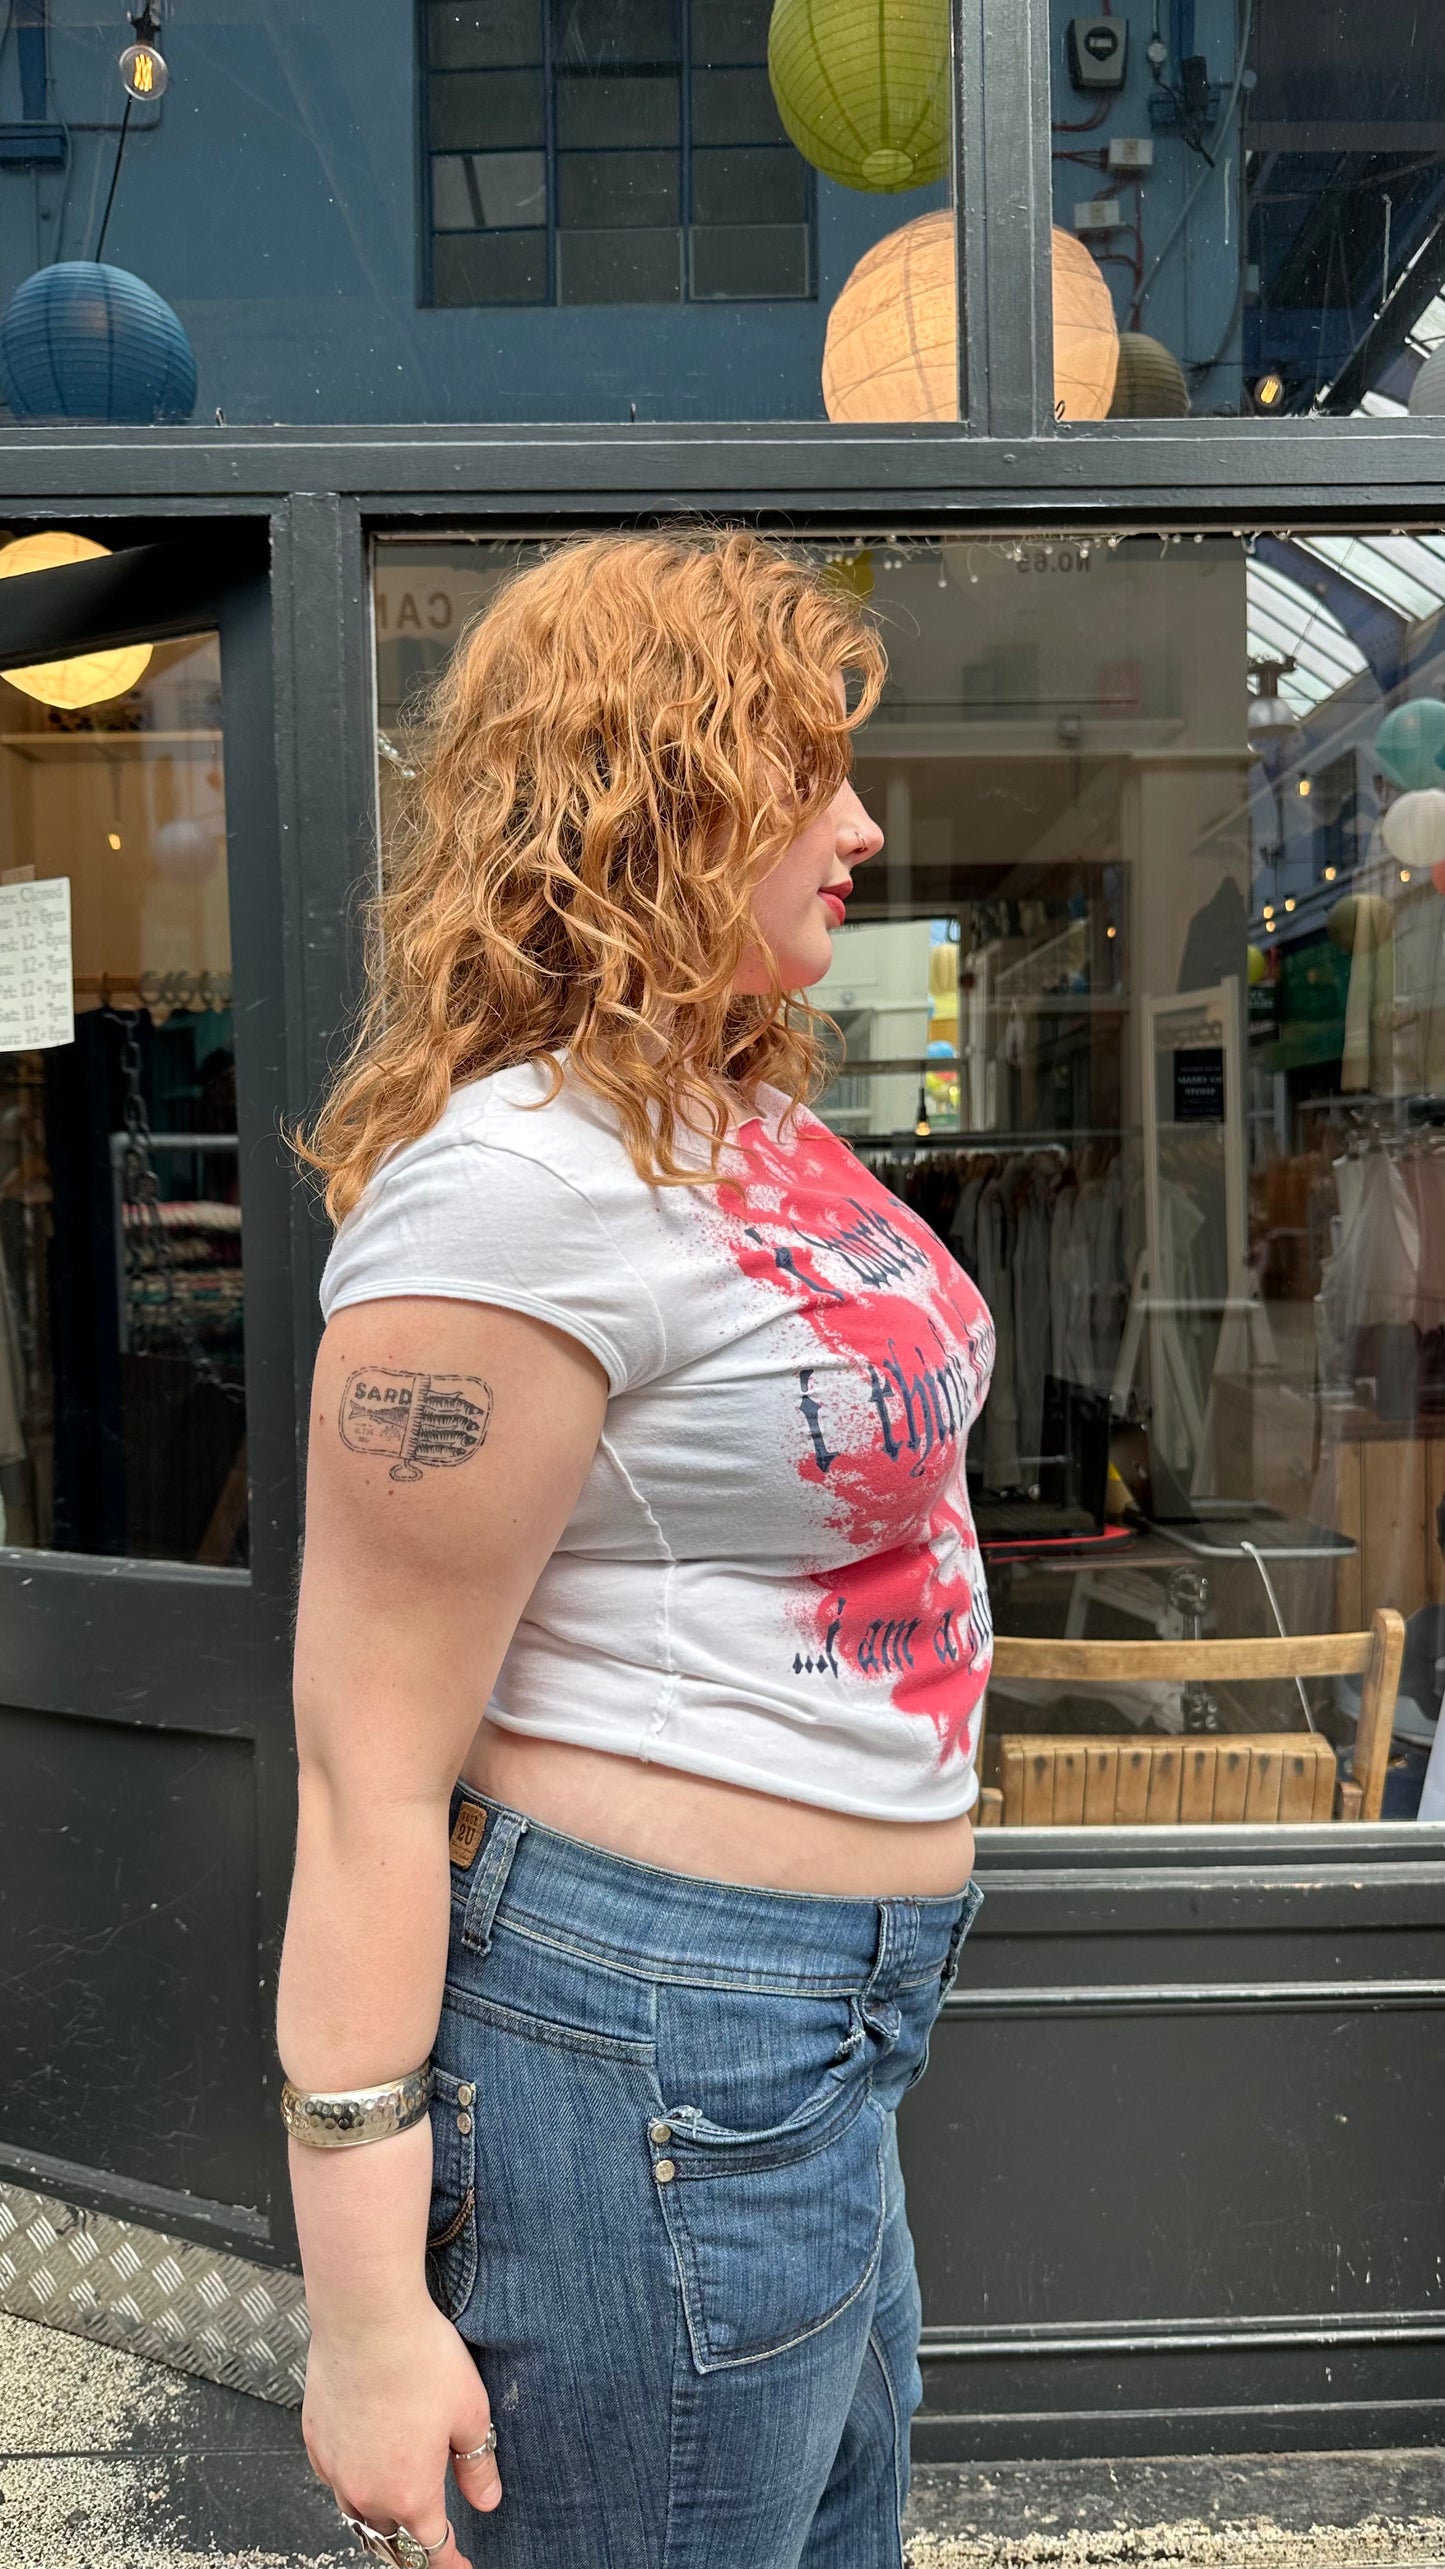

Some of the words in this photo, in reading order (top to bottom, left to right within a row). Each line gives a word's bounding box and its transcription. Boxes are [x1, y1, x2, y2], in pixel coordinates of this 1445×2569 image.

[20, 883, 64, 903] Closed
[355, 1382, 412, 1405] SARD
[857, 1617, 922, 1675] am
